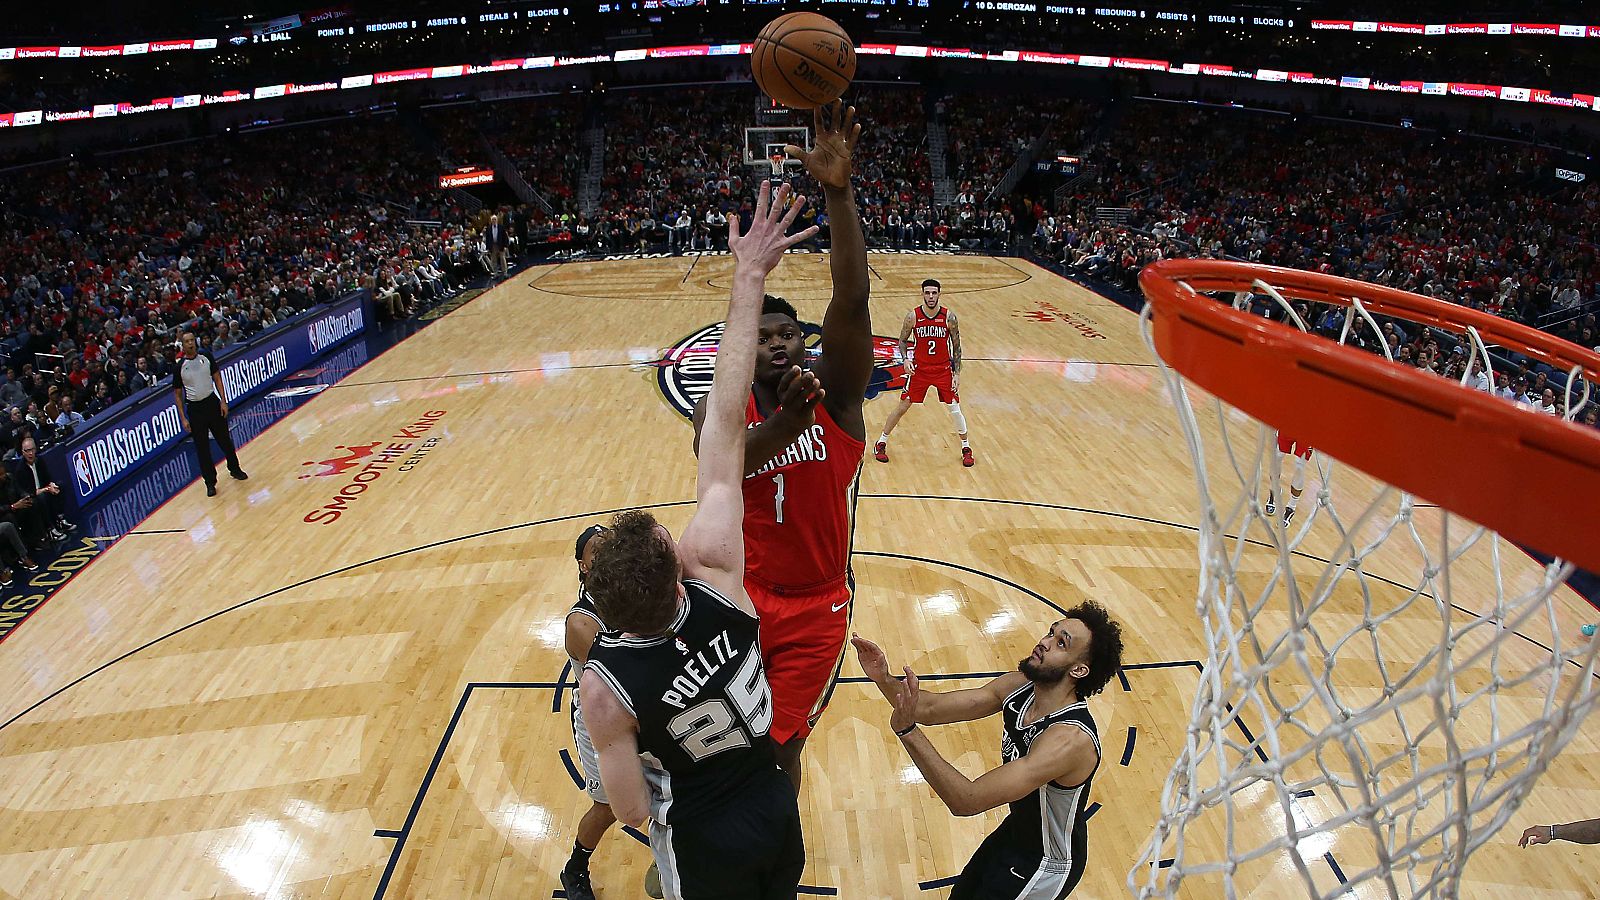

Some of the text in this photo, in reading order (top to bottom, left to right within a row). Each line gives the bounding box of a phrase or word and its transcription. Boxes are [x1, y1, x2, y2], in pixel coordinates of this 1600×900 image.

[271, 32, 291, 41] BALL
[318, 28, 344, 37] POINTS
[366, 22, 408, 32] REBOUNDS
[427, 17, 458, 27] ASSISTS
[480, 12, 508, 21] STEALS
[528, 8, 559, 17] BLOCKS
[1046, 6, 1073, 14] POINTS
[1095, 8, 1136, 17] REBOUNDS
[1156, 12, 1188, 21] ASSISTS
[1254, 18, 1284, 27] BLOCKS
[604, 252, 672, 260] NEW
[315, 308, 364, 351] NBAStore.com
[916, 326, 947, 338] PELICANS
[928, 340, 936, 354] 2
[221, 345, 287, 404] NBAStore.com
[87, 405, 181, 487] NBAStore.com
[398, 438, 440, 472] CENTER
[304, 443, 413, 525] SMOOTHIE
[772, 473, 784, 524] 1
[661, 630, 738, 709] POELTL
[666, 641, 773, 762] 25
